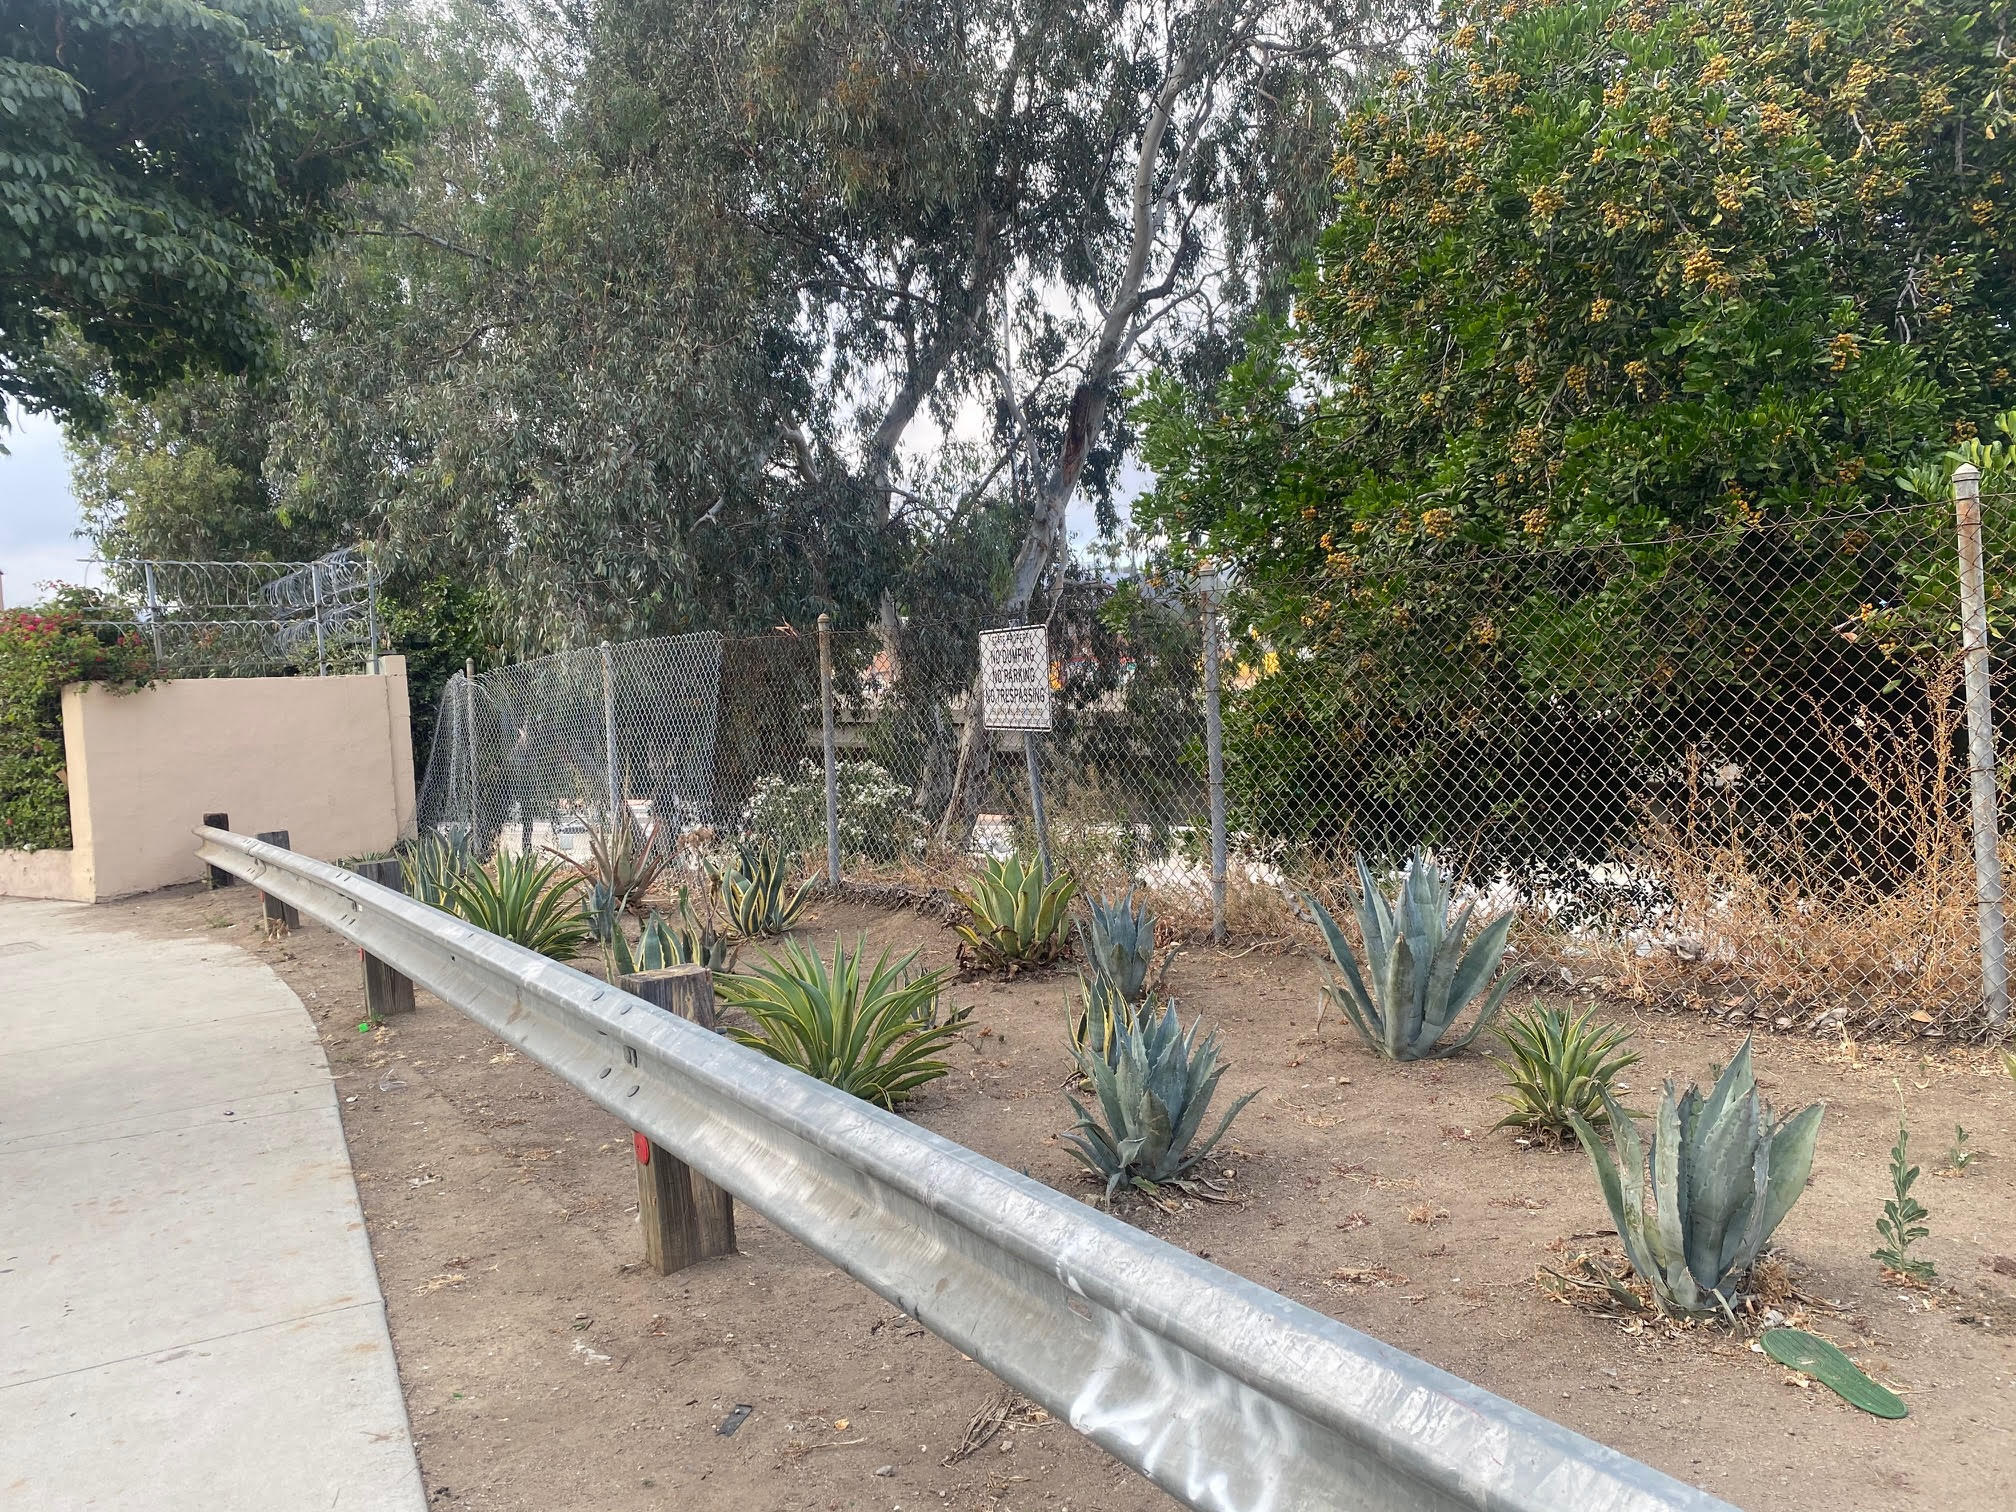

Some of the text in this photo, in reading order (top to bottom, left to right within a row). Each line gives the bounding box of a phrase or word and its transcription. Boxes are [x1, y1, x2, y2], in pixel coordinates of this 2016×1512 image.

[991, 647, 1034, 664] NO DUMPING
[992, 667, 1035, 683] NO PARKING
[986, 688, 1045, 703] NO TRESPASSING
